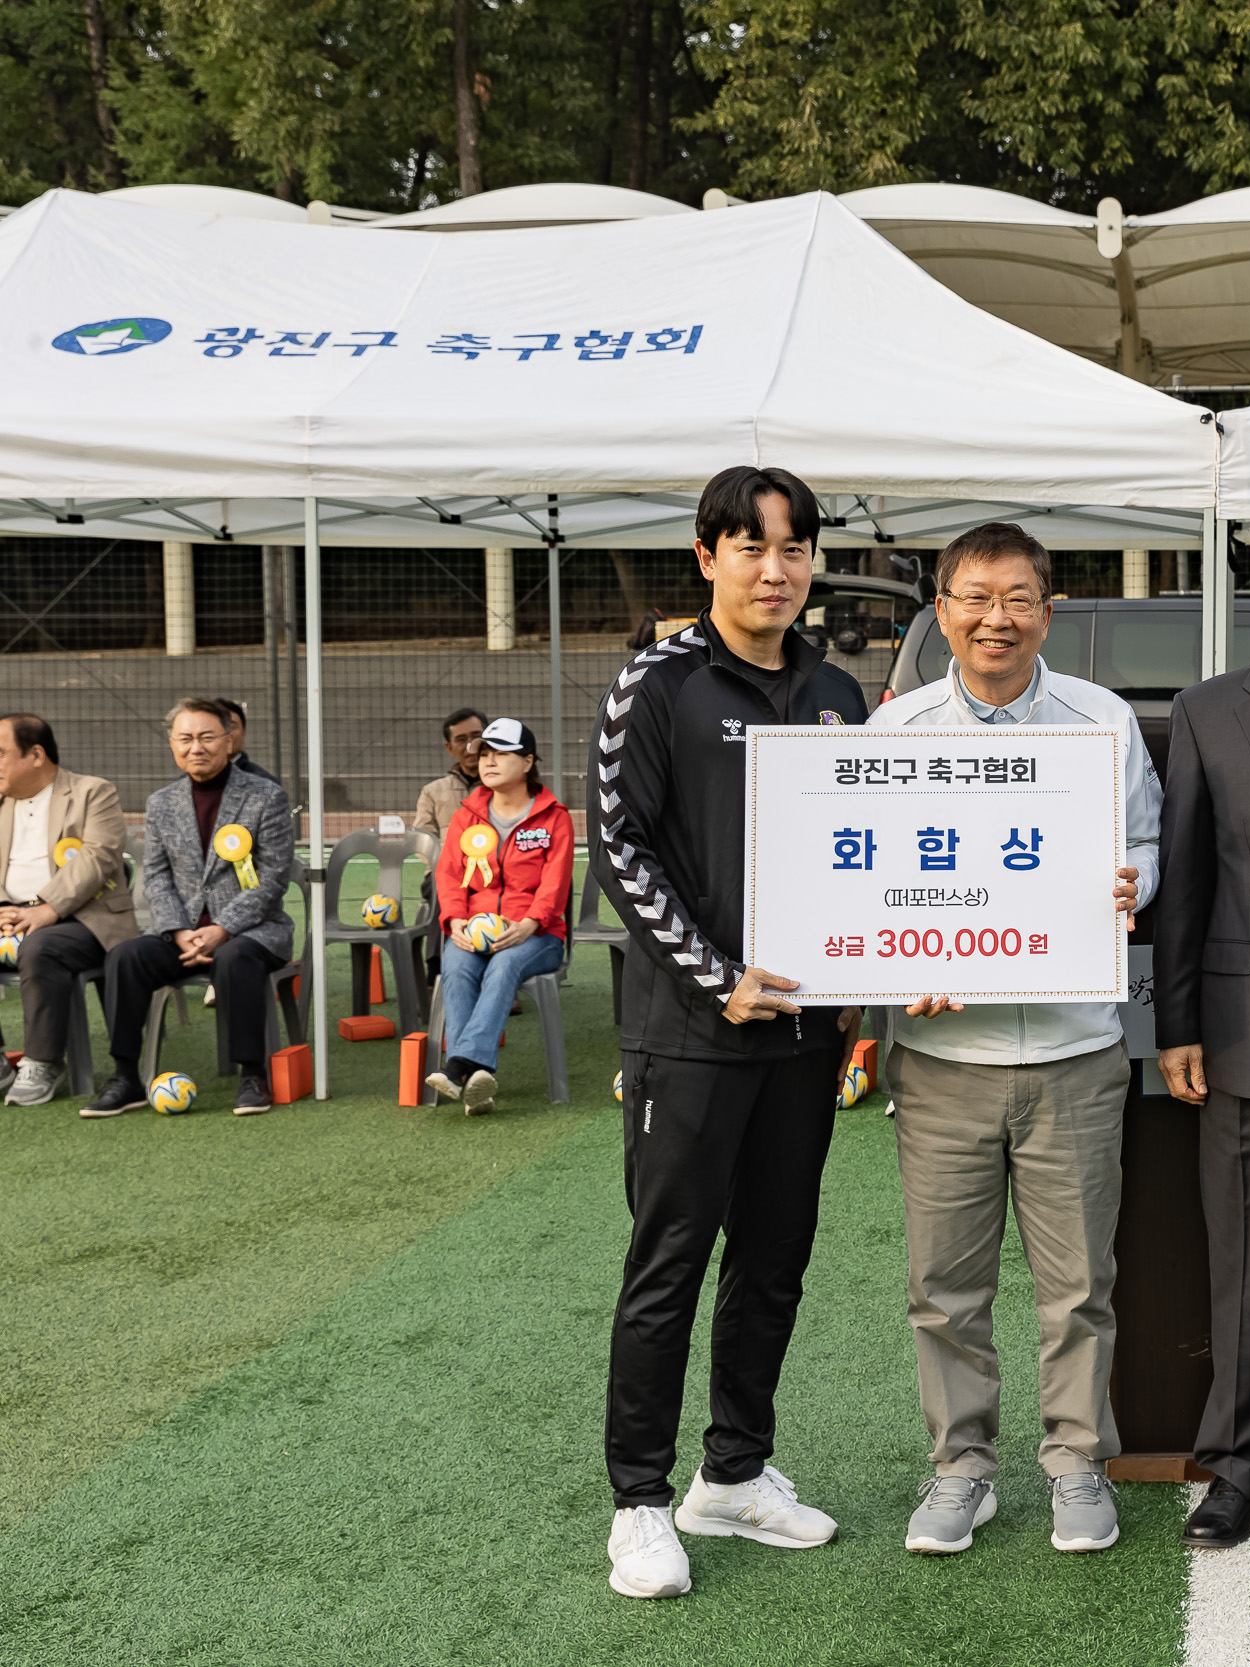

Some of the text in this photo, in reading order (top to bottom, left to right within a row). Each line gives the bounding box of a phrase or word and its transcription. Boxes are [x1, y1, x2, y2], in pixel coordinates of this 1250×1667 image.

[193, 324, 704, 362] 광진구 축구협회
[722, 734, 746, 743] humme
[834, 756, 1037, 785] 광진구 축구협회
[884, 887, 989, 908] (퍼포먼스상)
[824, 935, 865, 958] 상금
